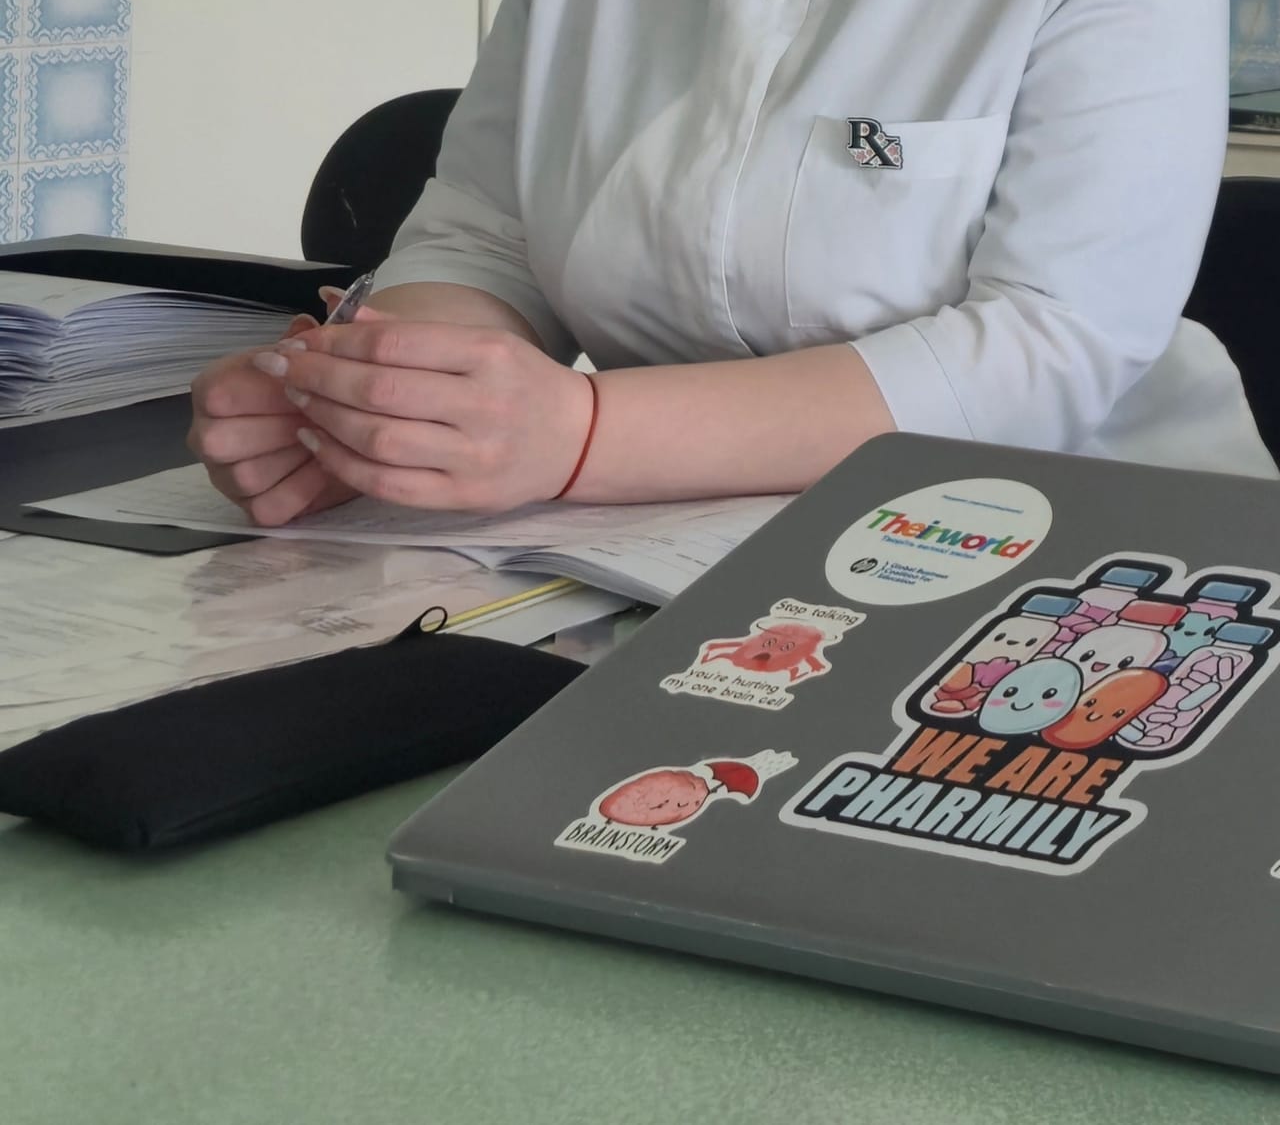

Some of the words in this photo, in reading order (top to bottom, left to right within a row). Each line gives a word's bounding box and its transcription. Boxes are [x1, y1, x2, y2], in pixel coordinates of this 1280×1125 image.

[866, 508, 1035, 559] Theirworld
[775, 600, 807, 617] Stop
[811, 606, 859, 626] talking
[664, 676, 688, 691] my
[692, 682, 717, 696] one
[721, 686, 756, 701] brain
[758, 693, 788, 708] cell
[731, 675, 780, 696] hurting
[891, 726, 1004, 782] WE
[992, 744, 1124, 806] ARE
[804, 766, 1122, 860] PHARMILY
[565, 821, 680, 860] BRAINSTORM
